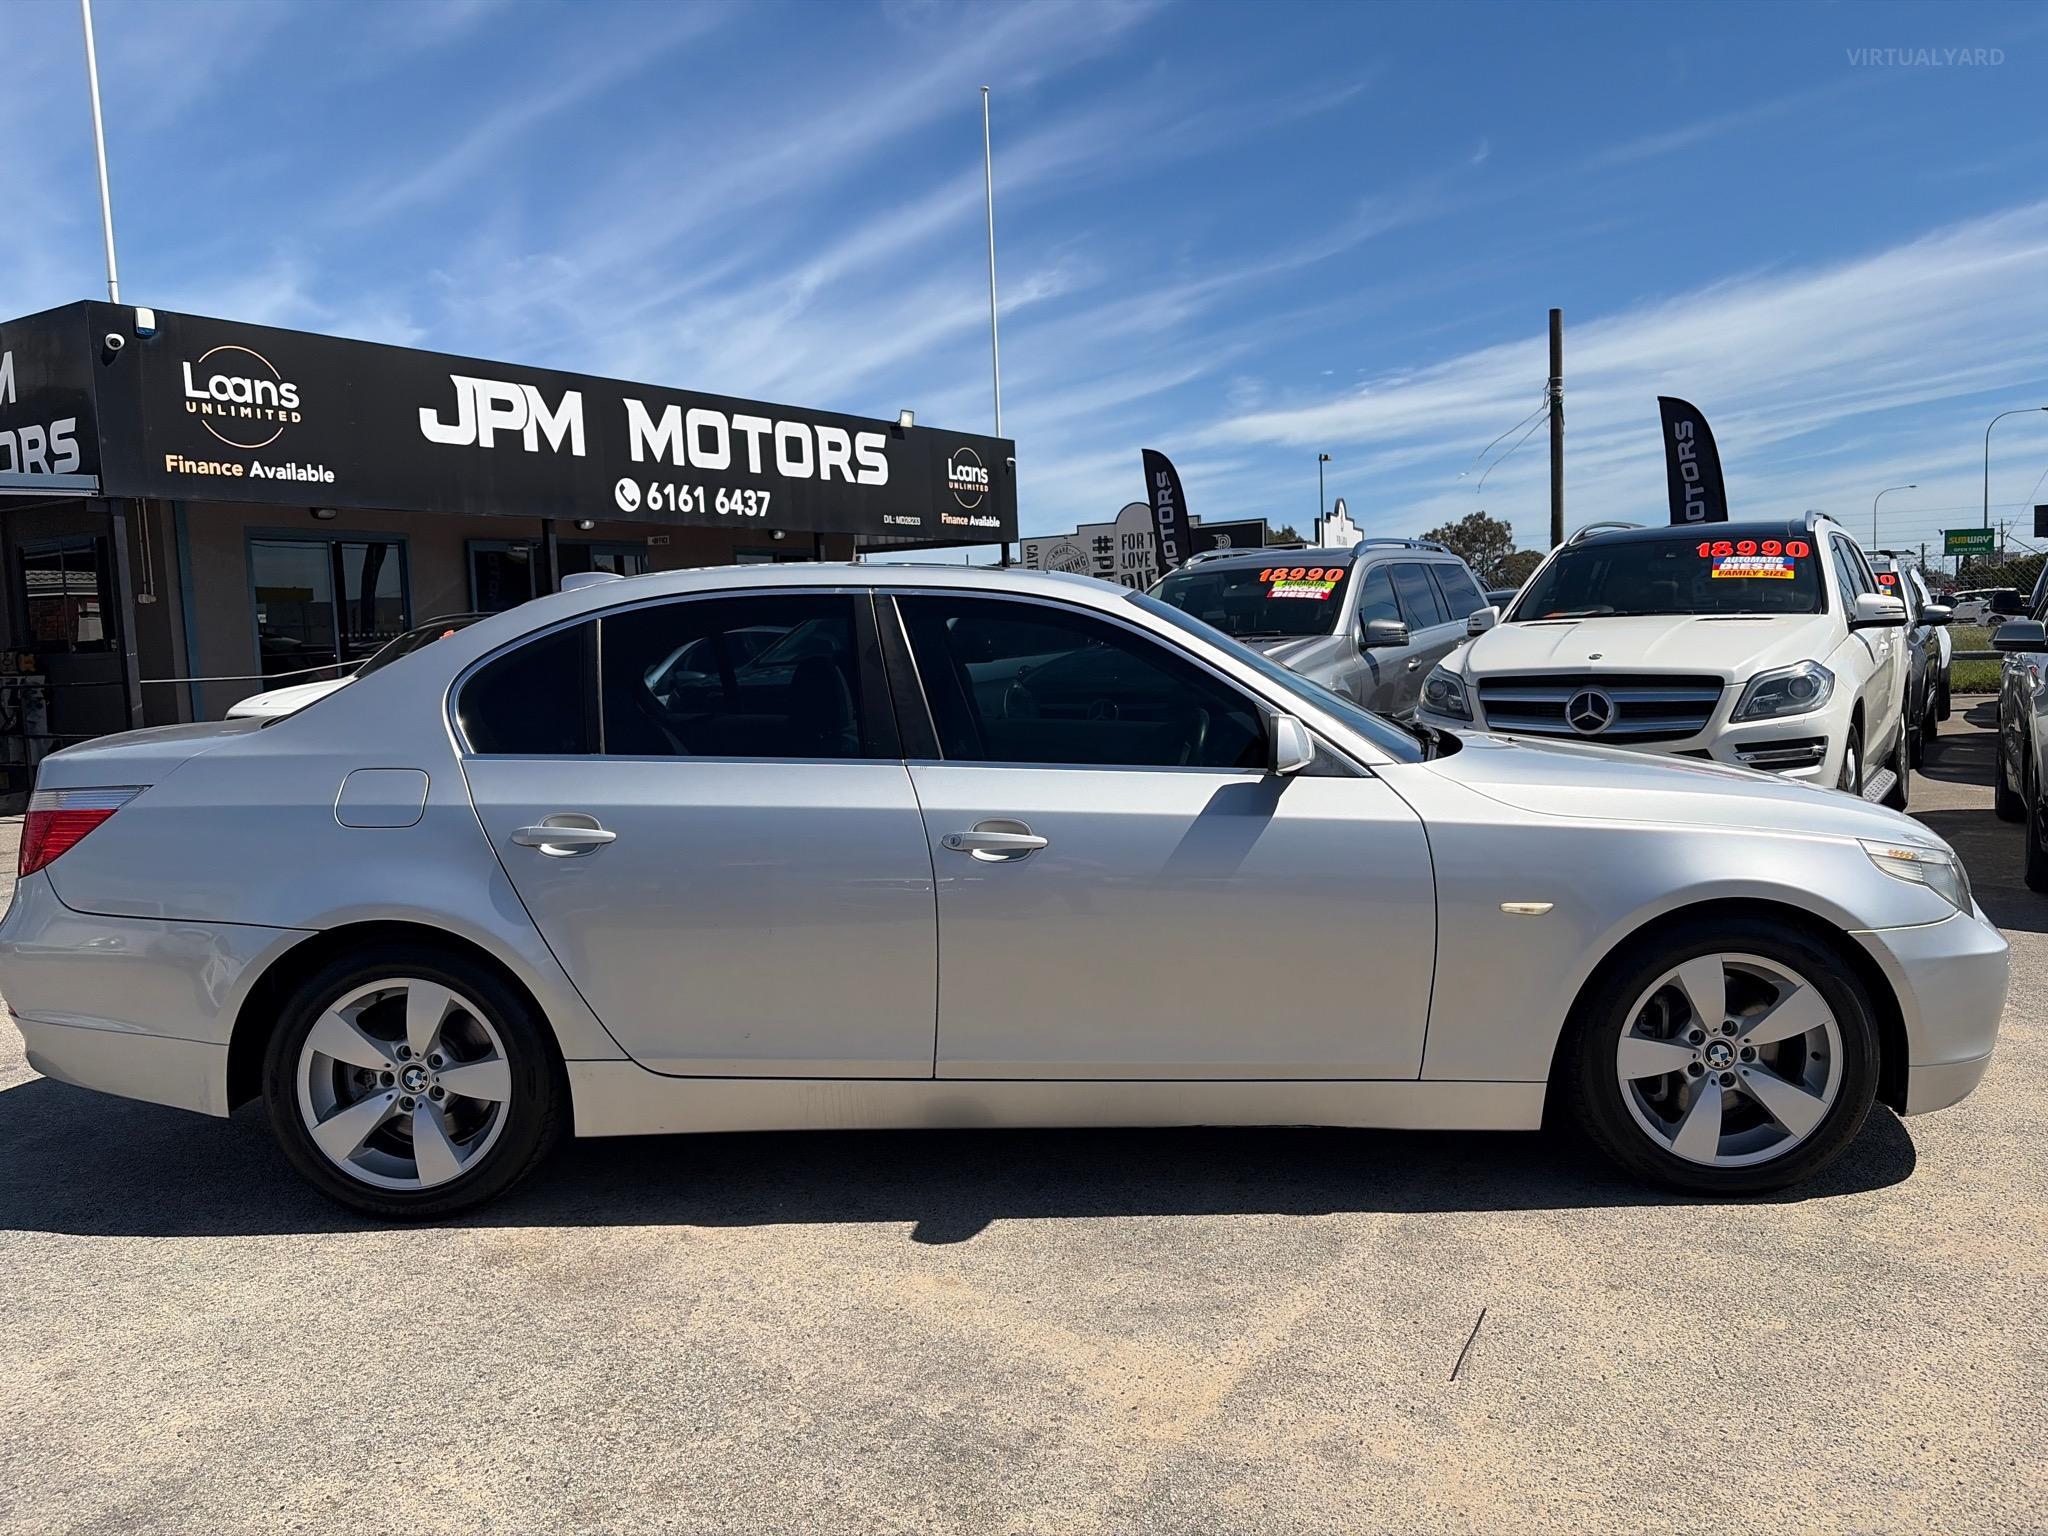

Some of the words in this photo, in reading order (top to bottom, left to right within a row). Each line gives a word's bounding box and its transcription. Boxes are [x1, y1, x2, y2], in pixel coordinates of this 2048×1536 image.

[182, 361, 300, 409] Loans
[185, 401, 302, 423] UNLIMITED
[419, 374, 586, 457] JPM
[622, 397, 888, 486] MOTORS
[165, 454, 244, 478] Finance
[249, 460, 335, 483] Available
[947, 458, 989, 484] Loans
[1674, 420, 1706, 521] OTORS
[948, 481, 989, 492] UNLIMITED
[647, 482, 706, 514] 6161
[714, 487, 771, 517] 6437
[941, 512, 969, 526] Finance
[969, 515, 1001, 528] Available
[1121, 532, 1145, 551] FOR
[1696, 540, 1810, 558] 18990
[1947, 535, 1993, 545] SUBWAY
[1121, 551, 1151, 569] LOVE
[1719, 563, 1787, 571] DIESEL
[1723, 556, 1785, 564] AUTOMATIC
[1259, 567, 1345, 583] 18990
